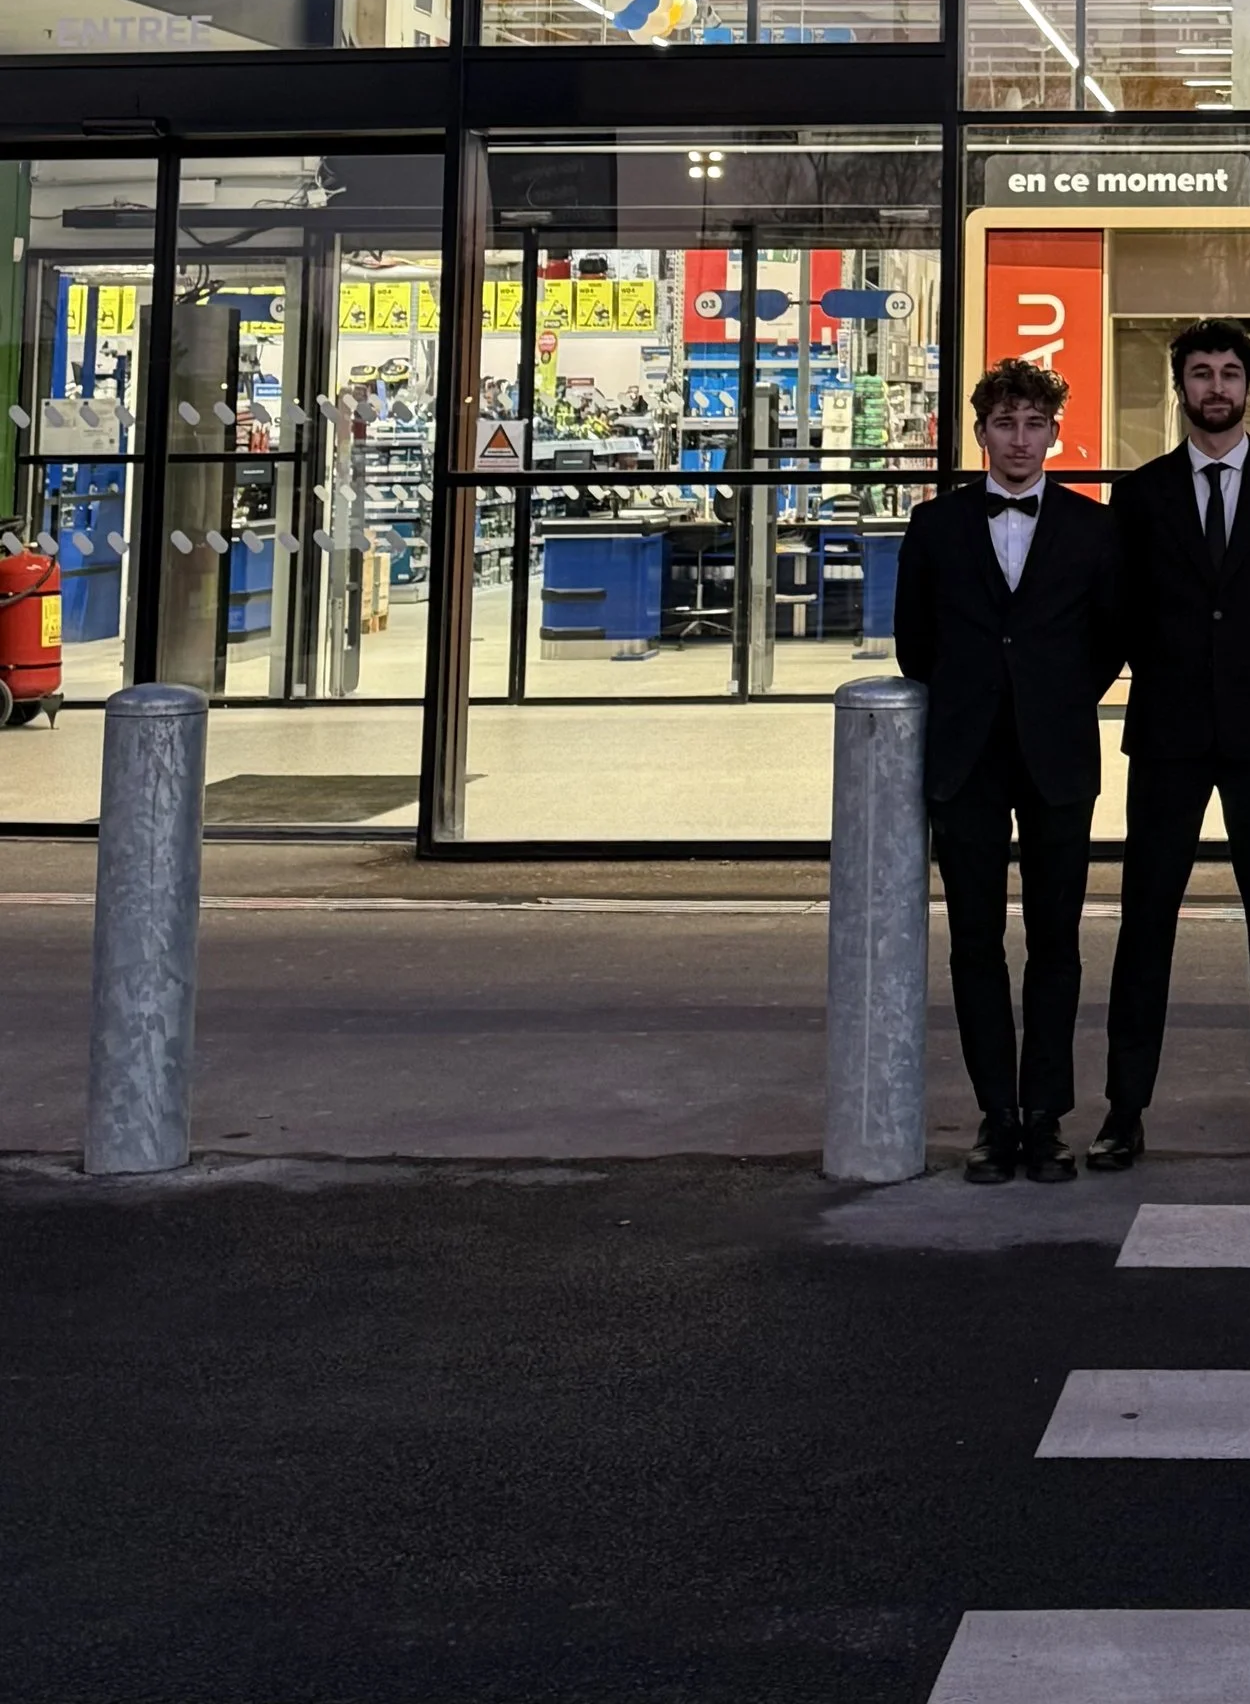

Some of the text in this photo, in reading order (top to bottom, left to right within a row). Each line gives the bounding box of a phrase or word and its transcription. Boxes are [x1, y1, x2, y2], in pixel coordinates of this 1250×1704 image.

[57, 14, 213, 47] ENTREE
[1007, 168, 1228, 193] en ce moment
[701, 300, 716, 310] 03
[892, 301, 906, 310] 02
